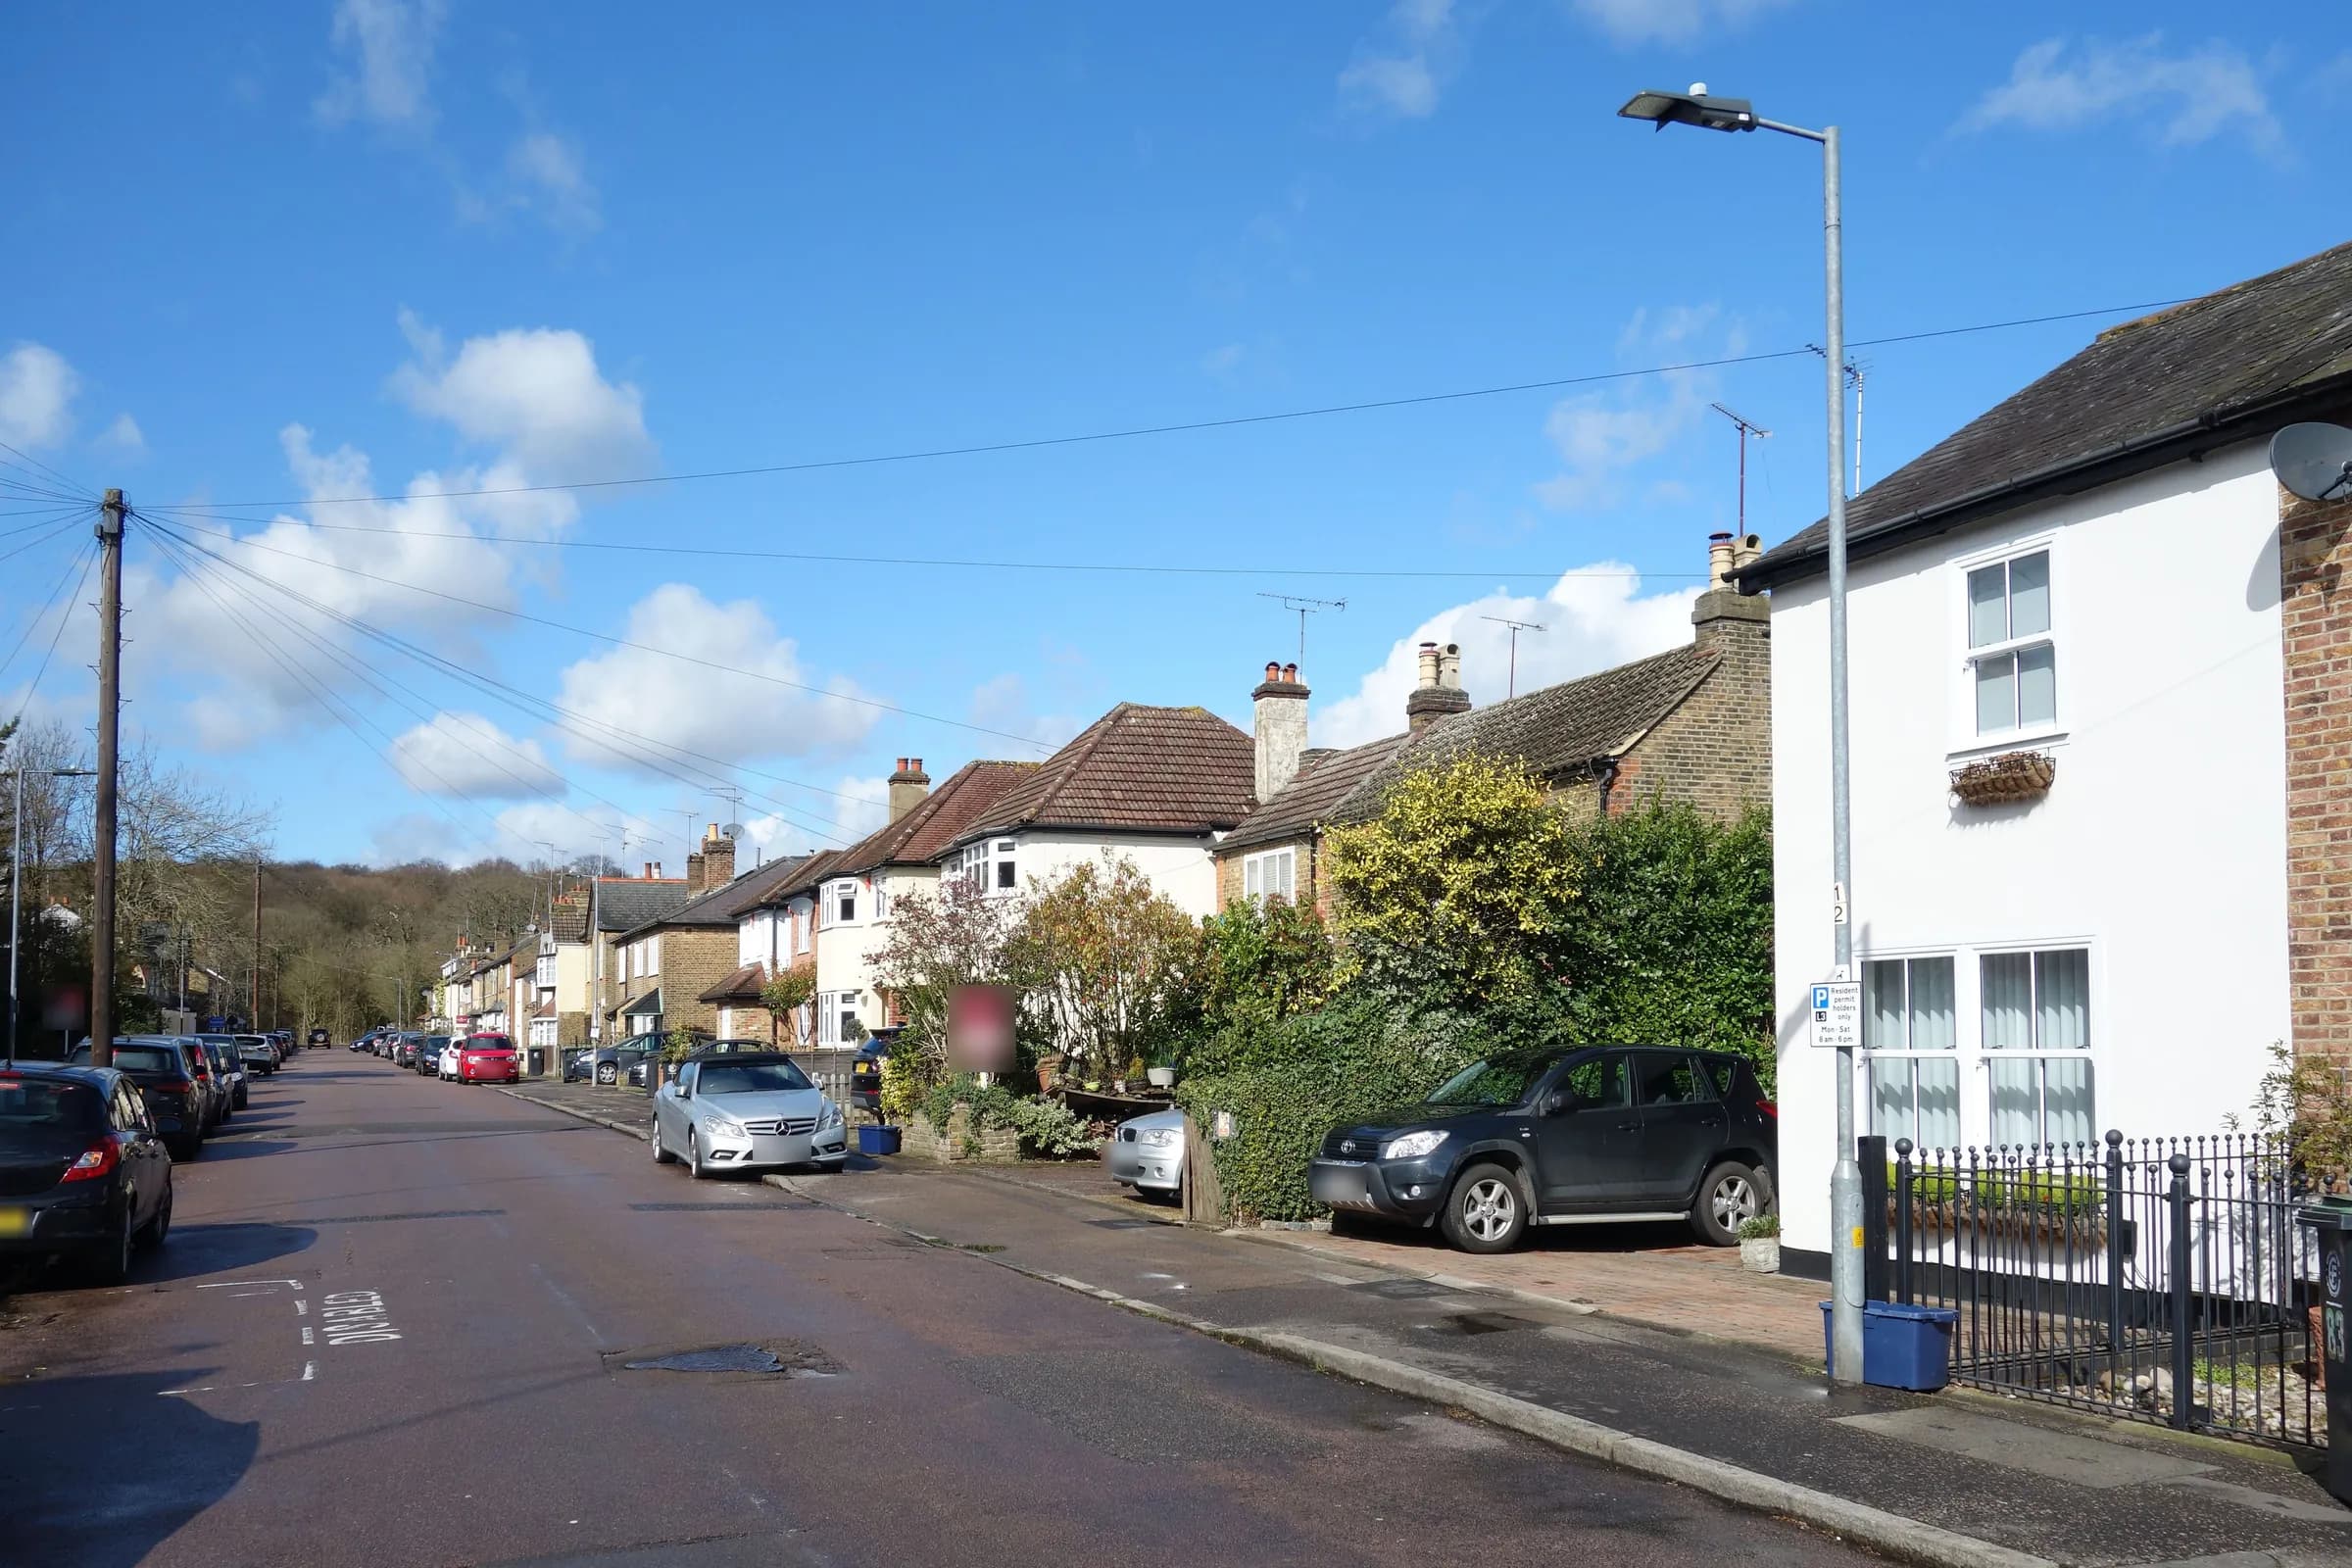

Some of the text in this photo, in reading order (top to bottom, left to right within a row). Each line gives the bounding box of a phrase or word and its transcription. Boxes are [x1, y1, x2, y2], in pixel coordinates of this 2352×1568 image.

[1835, 906, 1842, 922] 2
[1816, 989, 1827, 1007] P
[321, 1291, 403, 1347] DISABLED
